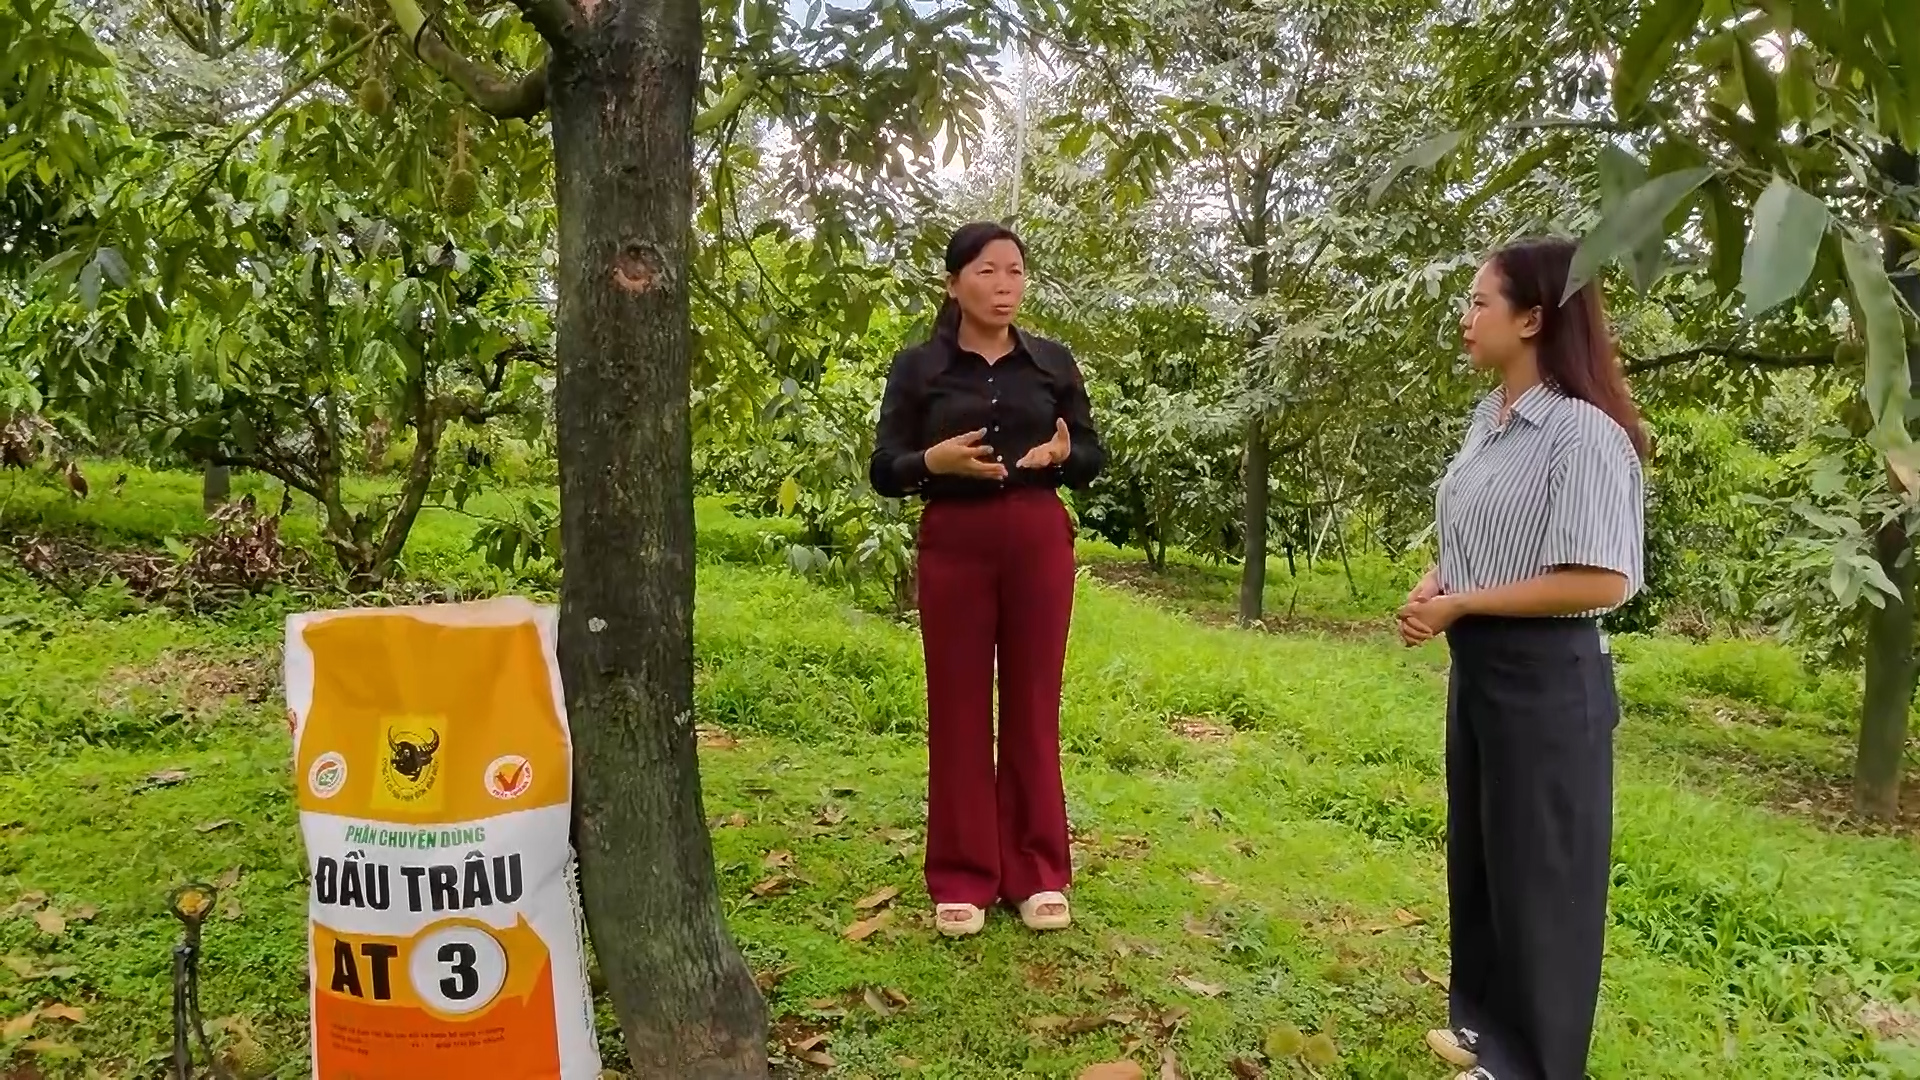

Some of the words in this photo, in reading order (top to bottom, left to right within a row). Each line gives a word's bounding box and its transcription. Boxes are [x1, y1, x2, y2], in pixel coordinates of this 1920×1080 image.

[344, 824, 377, 843] PHÂN
[379, 828, 437, 849] CHUYÊN
[440, 826, 486, 848] DÙNG
[315, 849, 390, 910] ĐẦU
[401, 849, 523, 912] TRÂU
[331, 938, 398, 1000] AT
[437, 943, 479, 1000] 3
